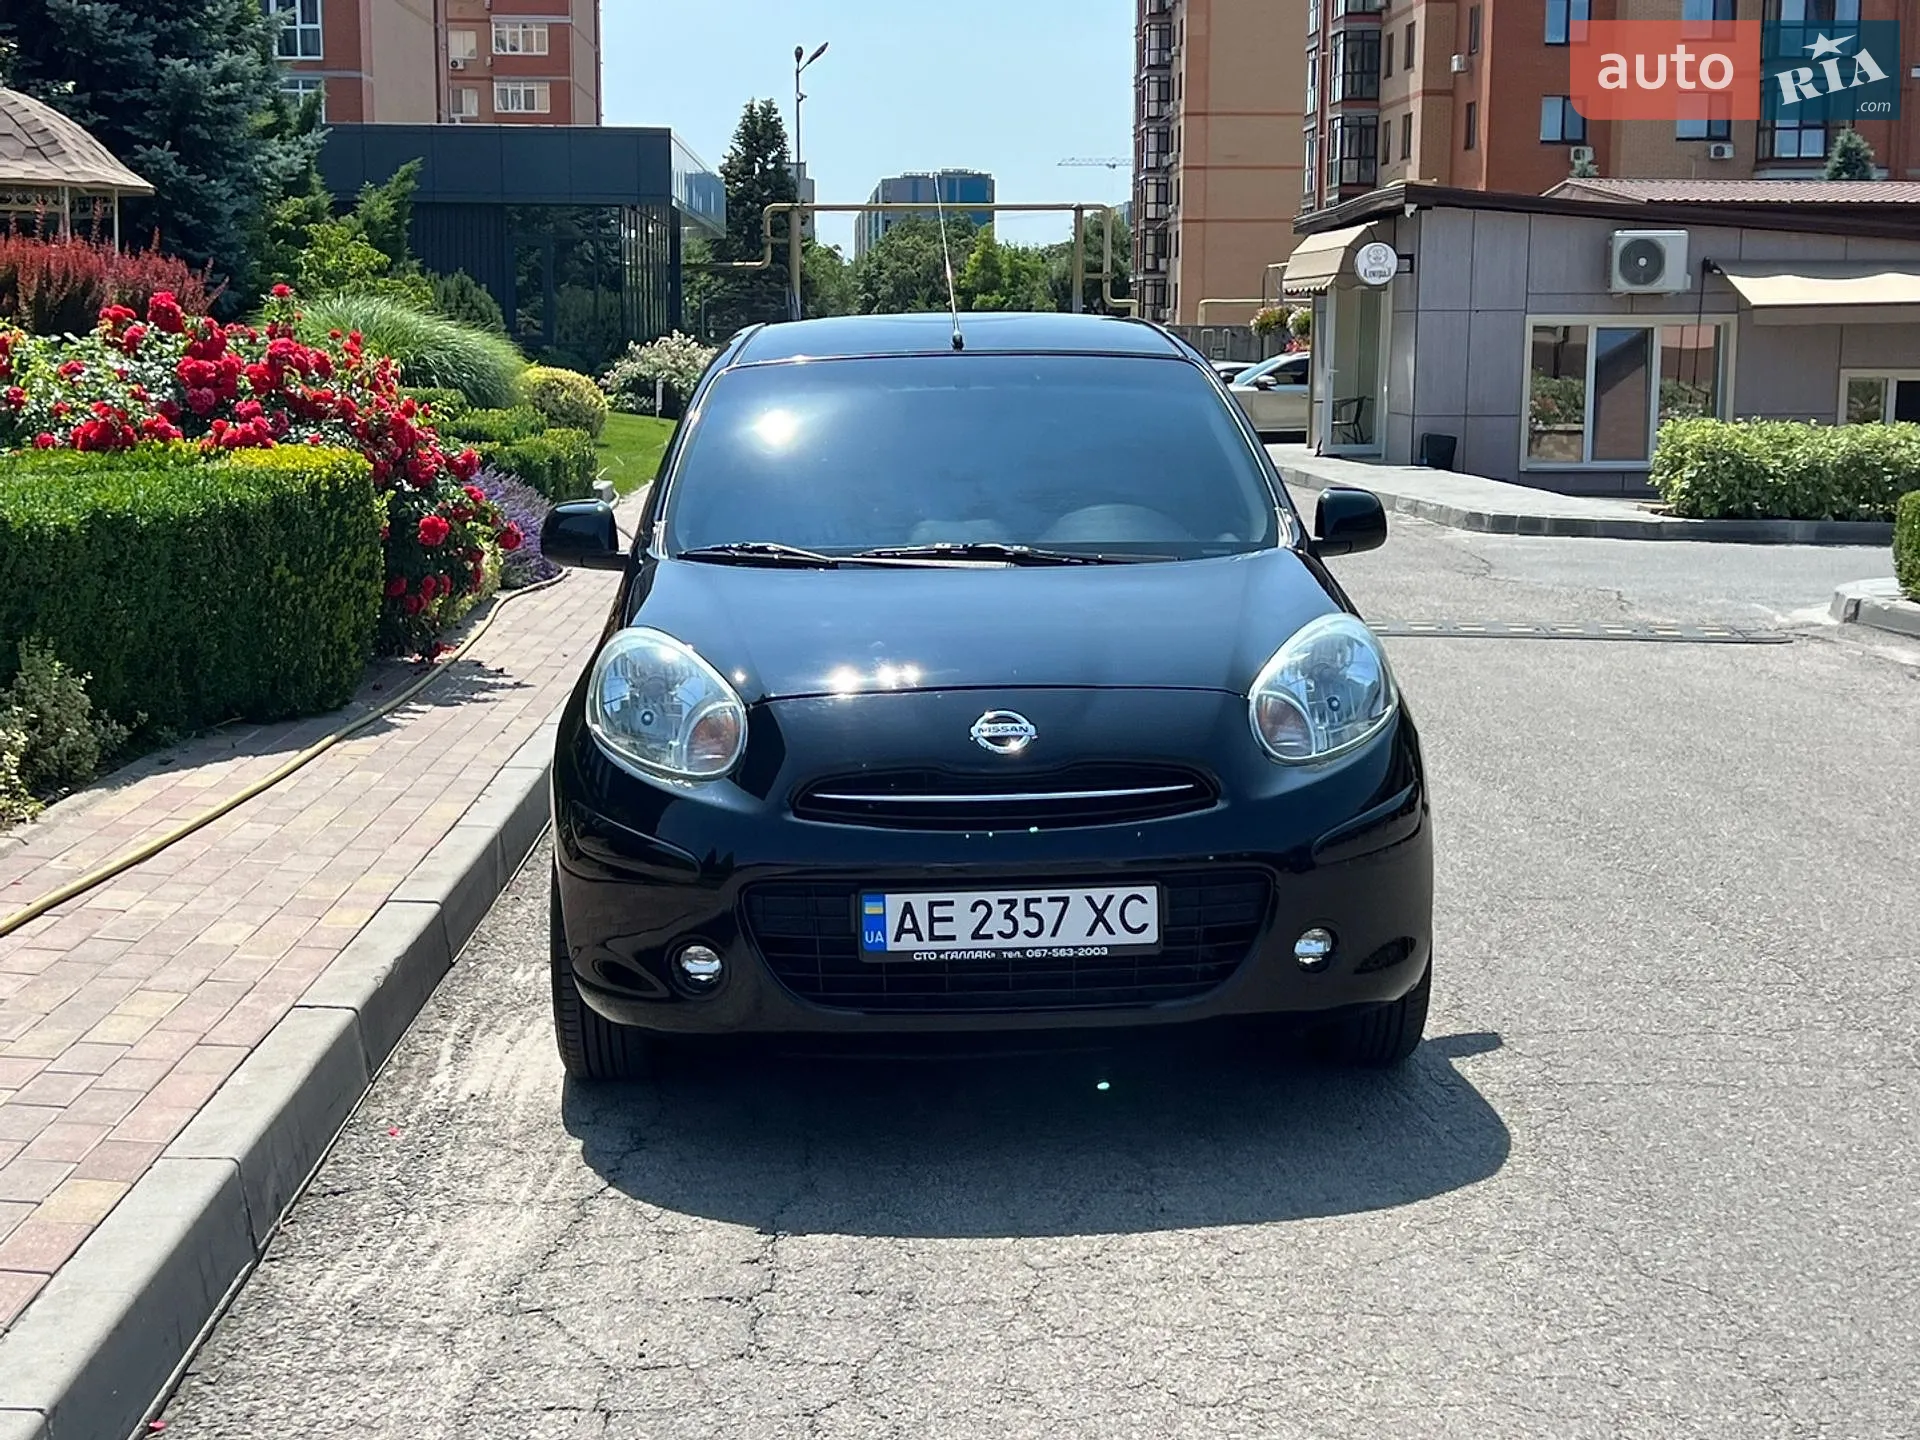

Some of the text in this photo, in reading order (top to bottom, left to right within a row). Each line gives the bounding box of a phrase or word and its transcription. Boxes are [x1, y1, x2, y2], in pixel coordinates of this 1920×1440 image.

[894, 894, 1149, 942] AE 2357 XC
[865, 930, 884, 944] UA
[913, 951, 937, 961] СТО
